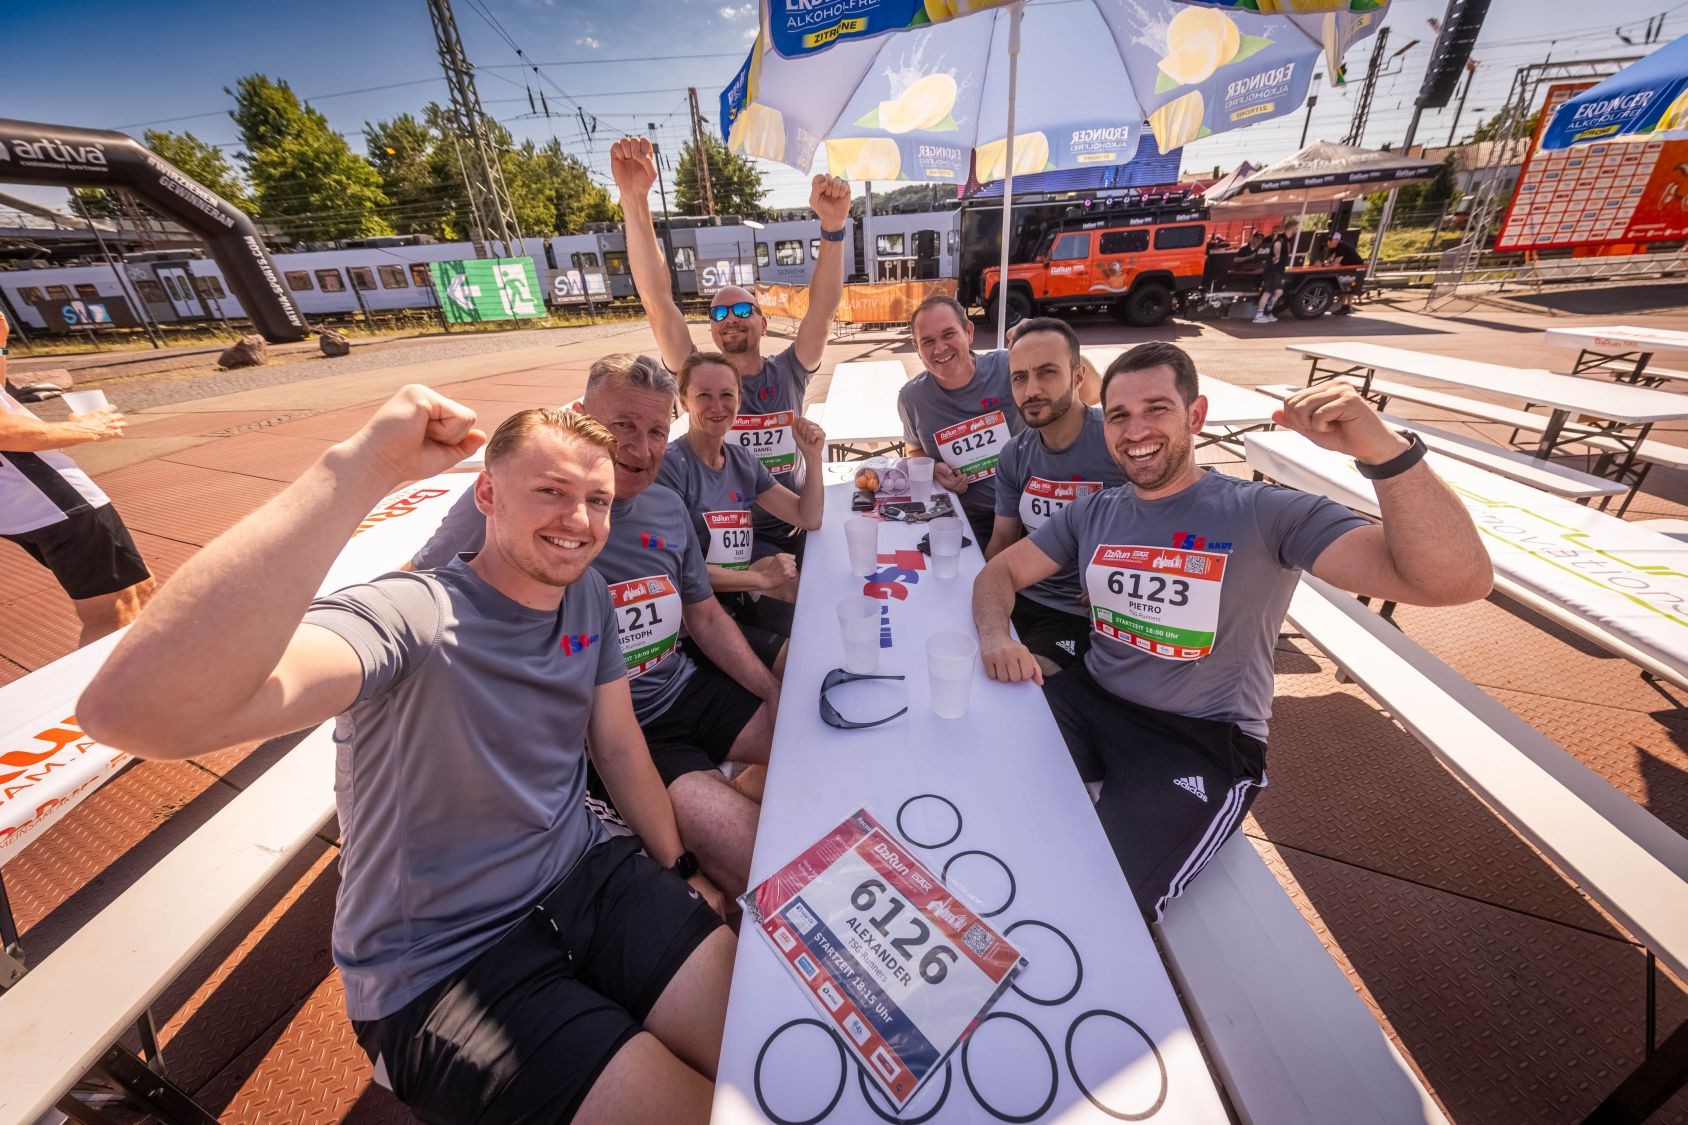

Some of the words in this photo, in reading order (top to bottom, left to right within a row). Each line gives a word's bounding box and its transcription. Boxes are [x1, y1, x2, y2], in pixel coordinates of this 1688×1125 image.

[1573, 91, 1654, 119] ERDINGER
[11, 138, 108, 165] artiva
[740, 429, 783, 447] 6127
[952, 429, 997, 456] 6122
[723, 530, 750, 549] 6120
[1172, 531, 1207, 550] TSG
[1107, 570, 1190, 607] 6123
[1129, 601, 1162, 614] PIETRO
[1115, 616, 1144, 632] STARTZEIT
[1145, 625, 1164, 637] 18:00
[1165, 631, 1180, 640] Uhr
[1173, 779, 1208, 802] adidas
[850, 878, 959, 986] 6126
[845, 916, 912, 987] ALEXANDER
[848, 936, 889, 984] TSG-Runners
[814, 931, 855, 977] STARTZEIT
[852, 976, 877, 1006] 18:15
[875, 1002, 893, 1024] Uhr
